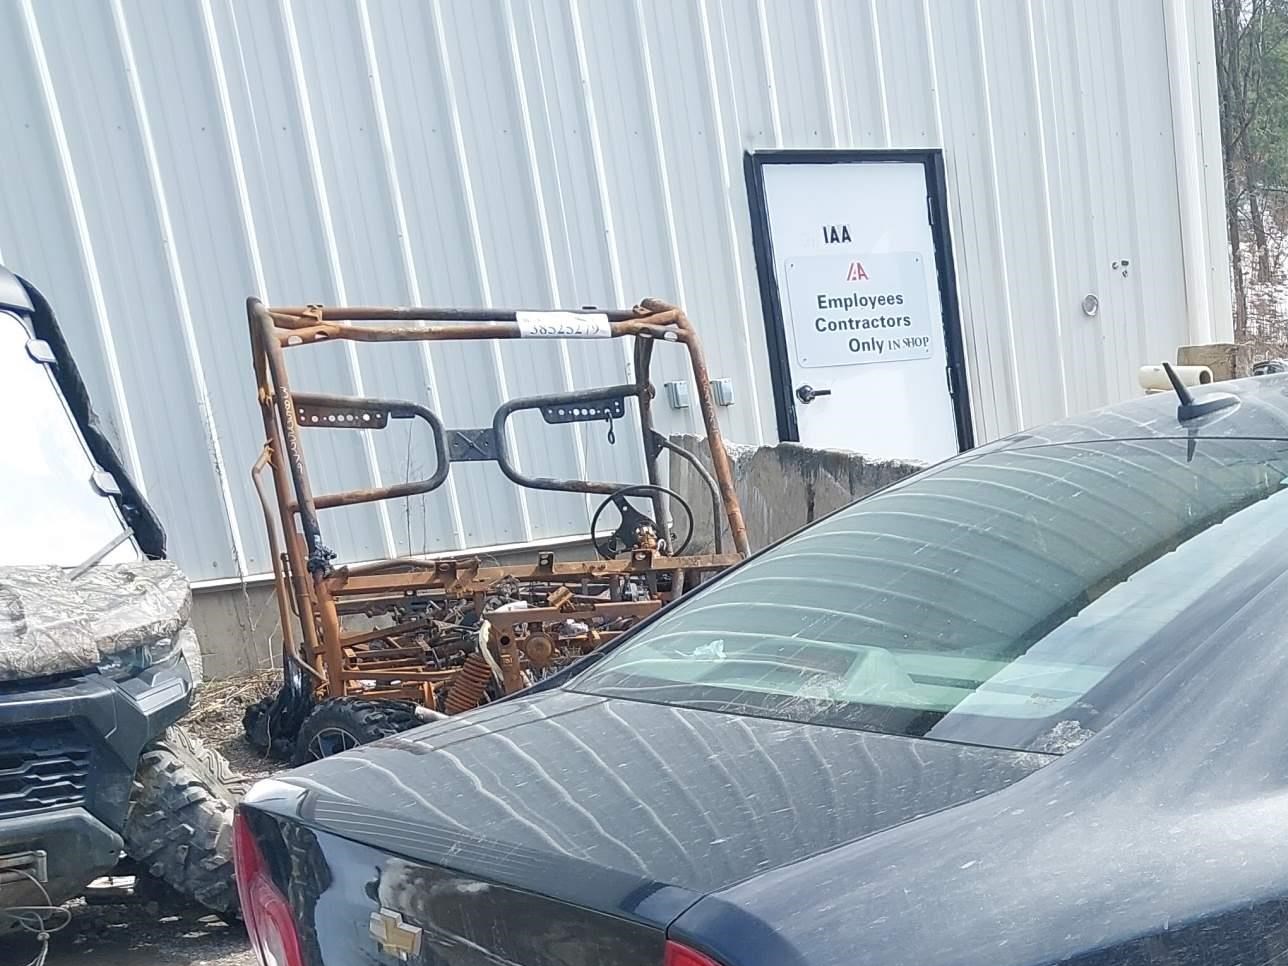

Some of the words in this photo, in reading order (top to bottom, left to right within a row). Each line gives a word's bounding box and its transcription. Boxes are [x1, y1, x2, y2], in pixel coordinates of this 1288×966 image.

[822, 225, 852, 244] IAA
[817, 293, 904, 312] Employees
[815, 315, 912, 333] Contractors
[849, 336, 884, 354] Only
[888, 339, 901, 351] IN
[902, 336, 929, 349] SHOP
